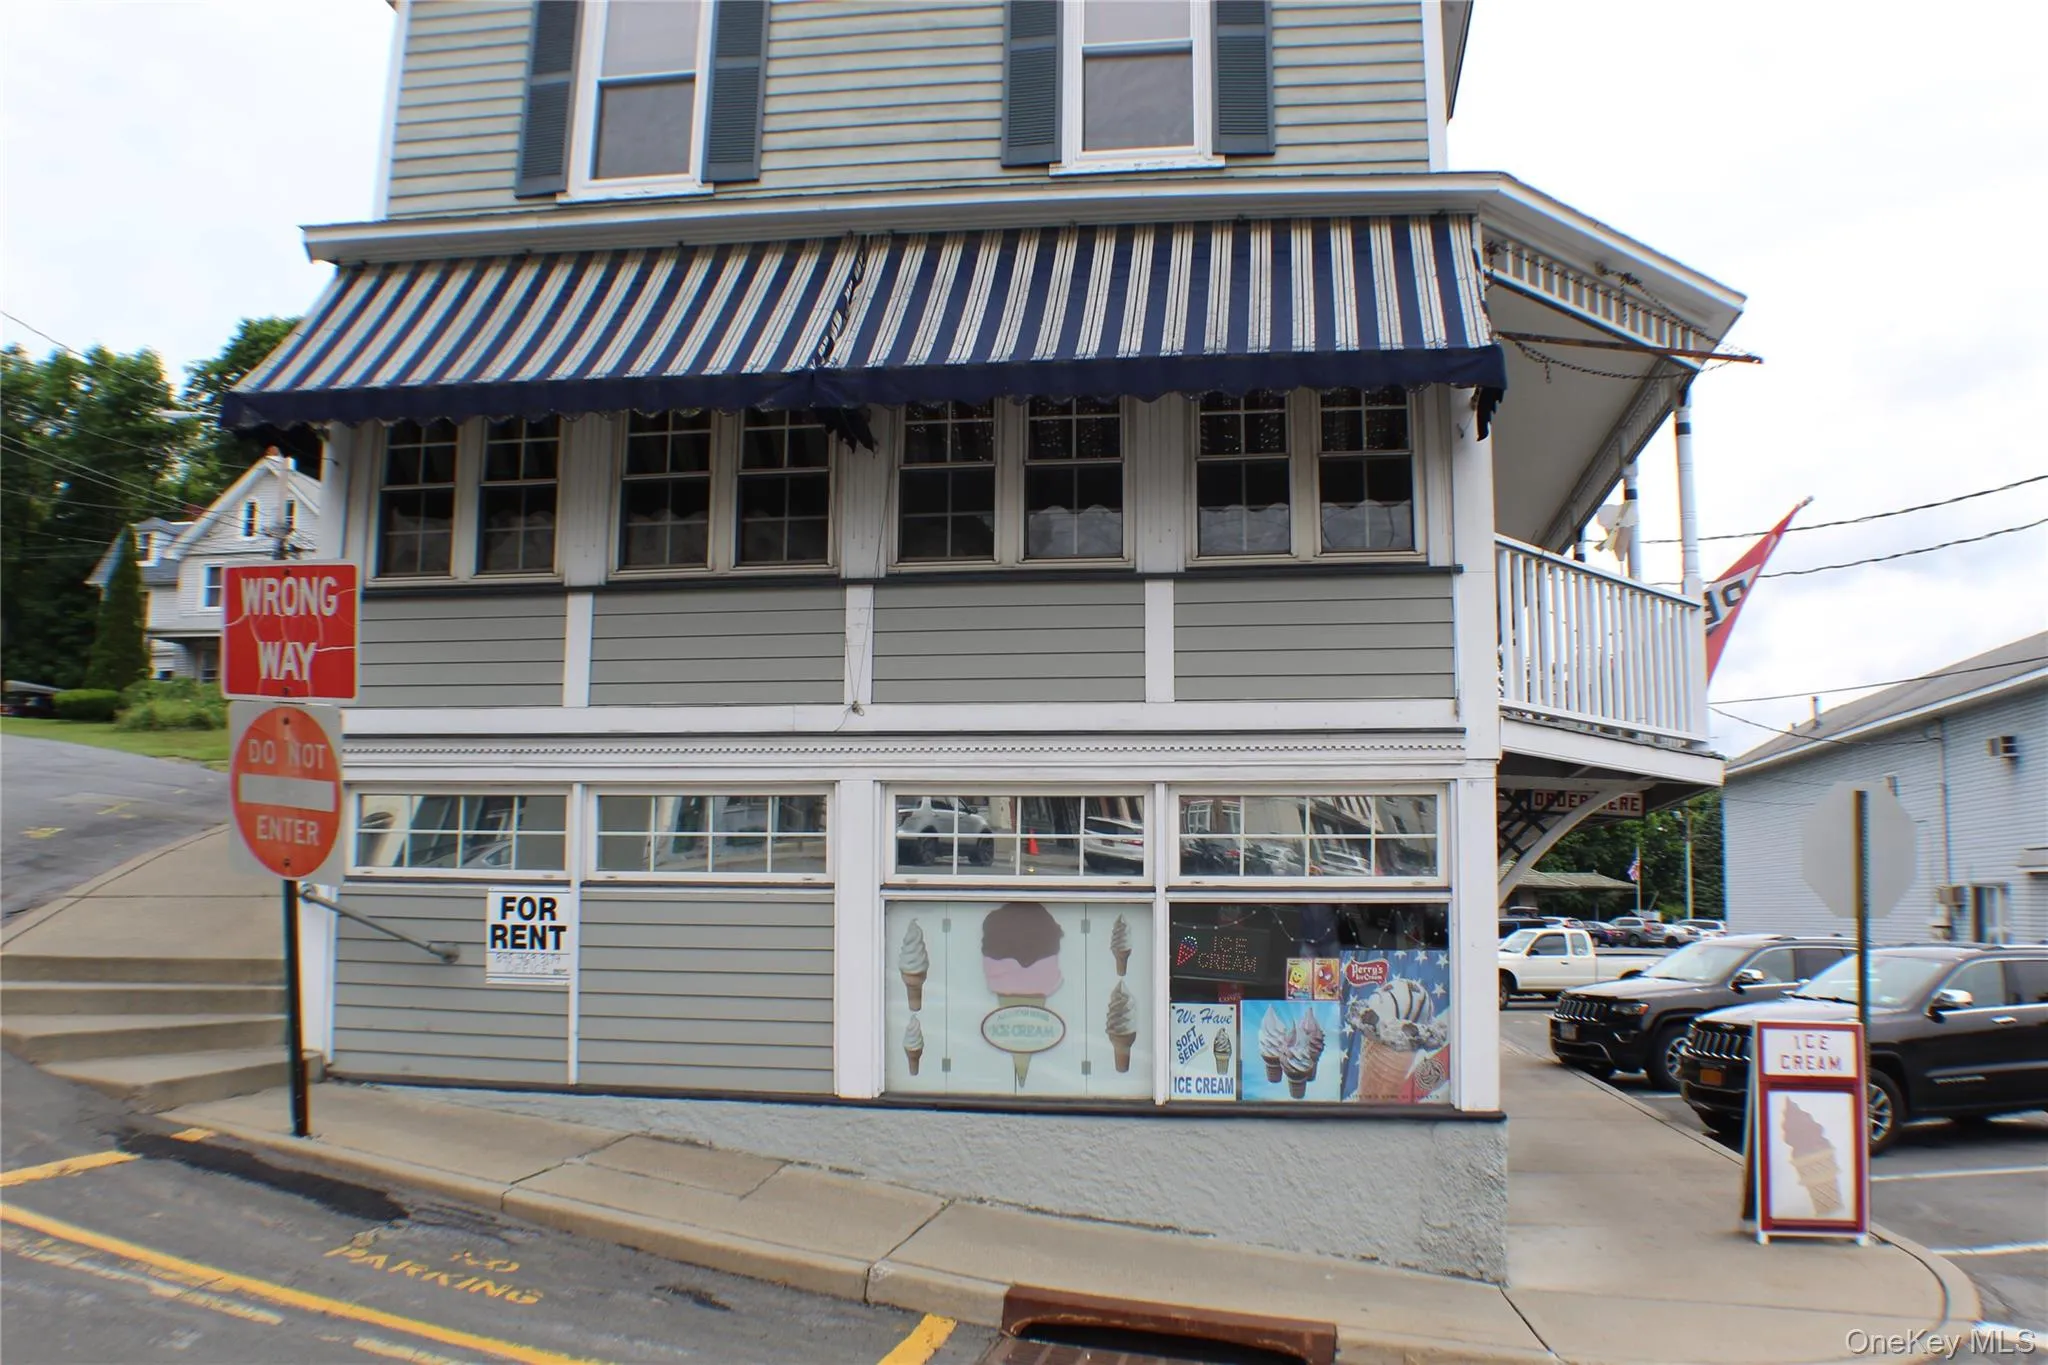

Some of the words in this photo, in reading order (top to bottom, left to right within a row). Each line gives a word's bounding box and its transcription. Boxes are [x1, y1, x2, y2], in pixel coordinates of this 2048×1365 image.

[240, 575, 339, 617] WRONG
[257, 640, 318, 681] WAY
[248, 738, 277, 765] DO
[286, 740, 327, 770] NOT
[255, 815, 321, 847] ENTER
[500, 896, 557, 921] FOR
[490, 924, 567, 951] RENT
[1213, 935, 1248, 954] ICE
[1198, 952, 1257, 973] CREAM
[1351, 963, 1384, 978] Perry's
[1176, 1008, 1196, 1024] We
[1199, 1007, 1233, 1024] Have
[1176, 1025, 1198, 1052] SOFT
[1178, 1033, 1206, 1065] SERVE
[1793, 1034, 1831, 1051] ICE
[1780, 1054, 1843, 1072] CREAM
[1174, 1076, 1192, 1094] ICE
[1195, 1076, 1234, 1095] CREAM
